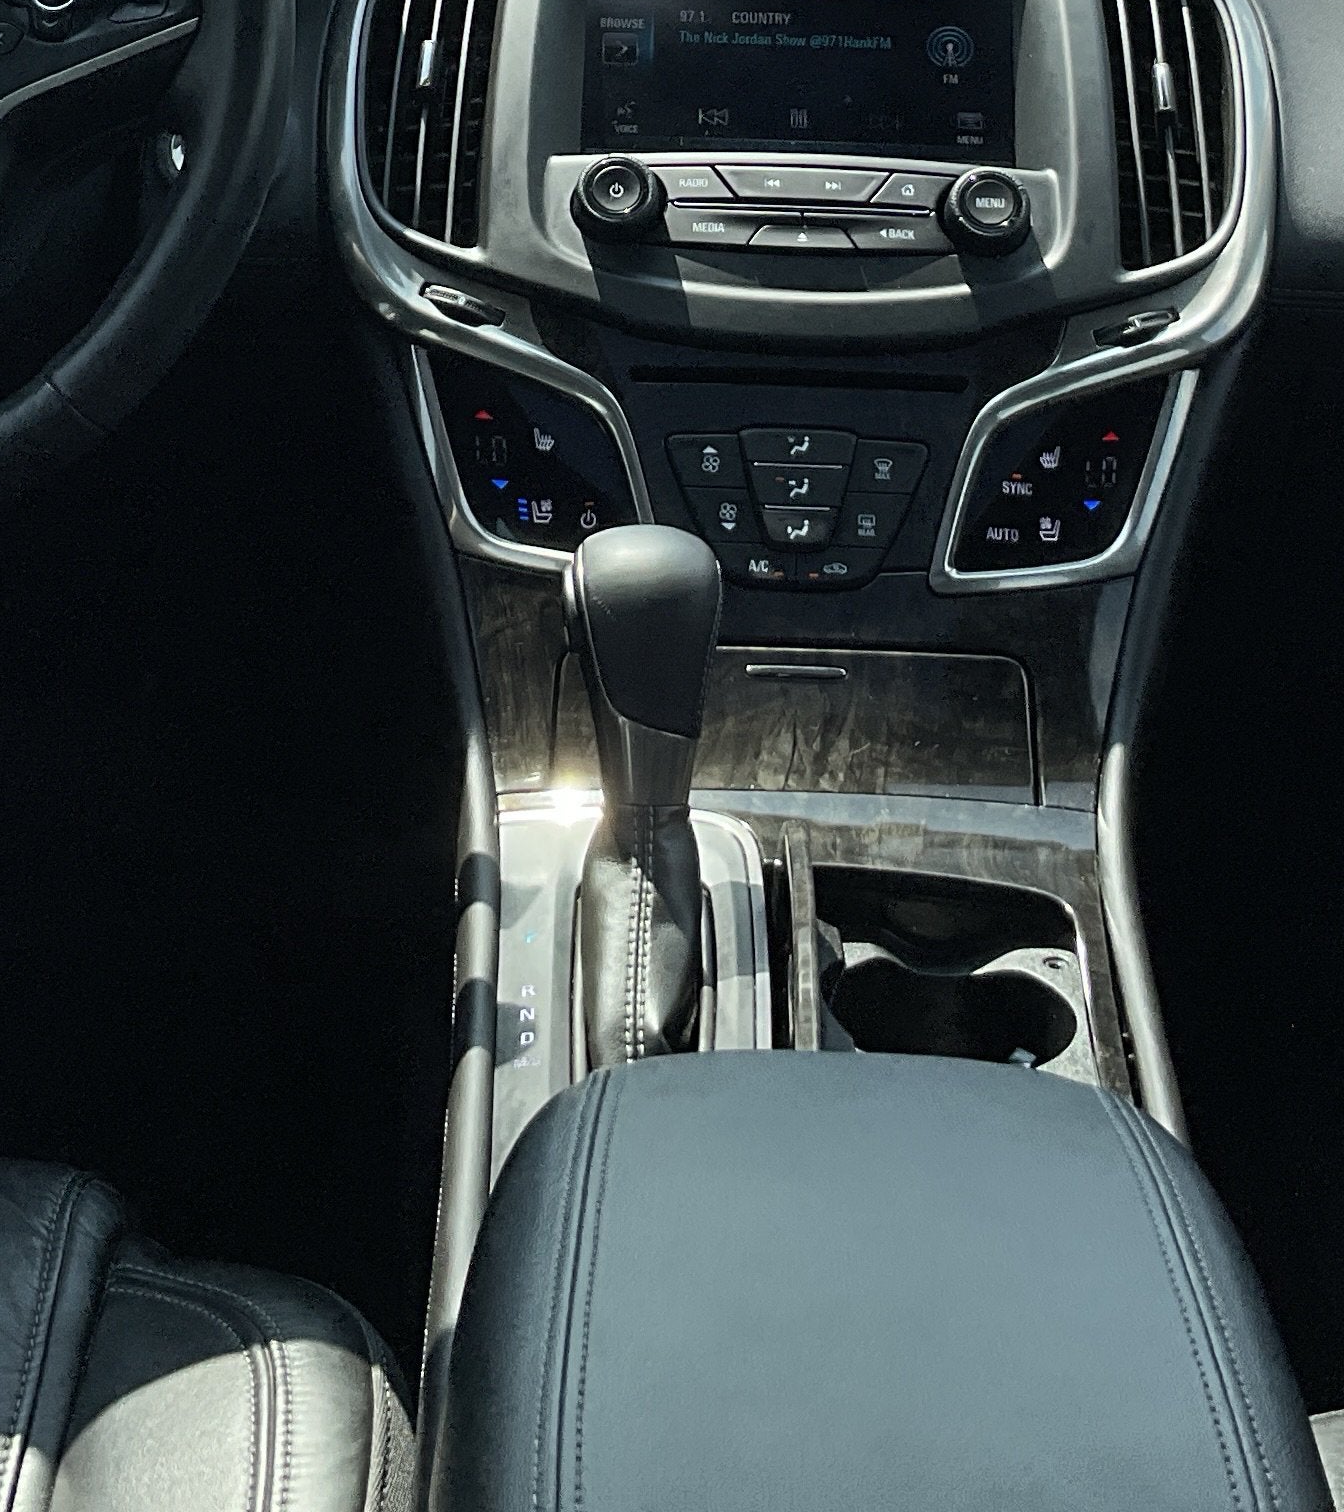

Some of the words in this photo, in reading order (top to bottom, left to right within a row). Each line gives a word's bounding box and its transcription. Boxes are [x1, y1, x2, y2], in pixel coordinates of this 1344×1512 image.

[599, 16, 646, 30] BROWSE
[731, 11, 792, 25] COUNTRY
[679, 30, 700, 43] The
[703, 31, 729, 44] Nick
[731, 32, 773, 46] Jordan
[775, 33, 807, 47] Show
[942, 73, 959, 85] FM
[678, 177, 709, 188] RADIO
[975, 197, 1006, 210] MENU
[691, 221, 725, 234] MEDIA
[888, 228, 916, 241] BACK
[1001, 479, 1034, 497] SYNC
[985, 526, 1020, 543] AUTO
[748, 558, 770, 573] A/C
[521, 984, 537, 998] R
[519, 1007, 535, 1022] N
[520, 1031, 535, 1046] D
